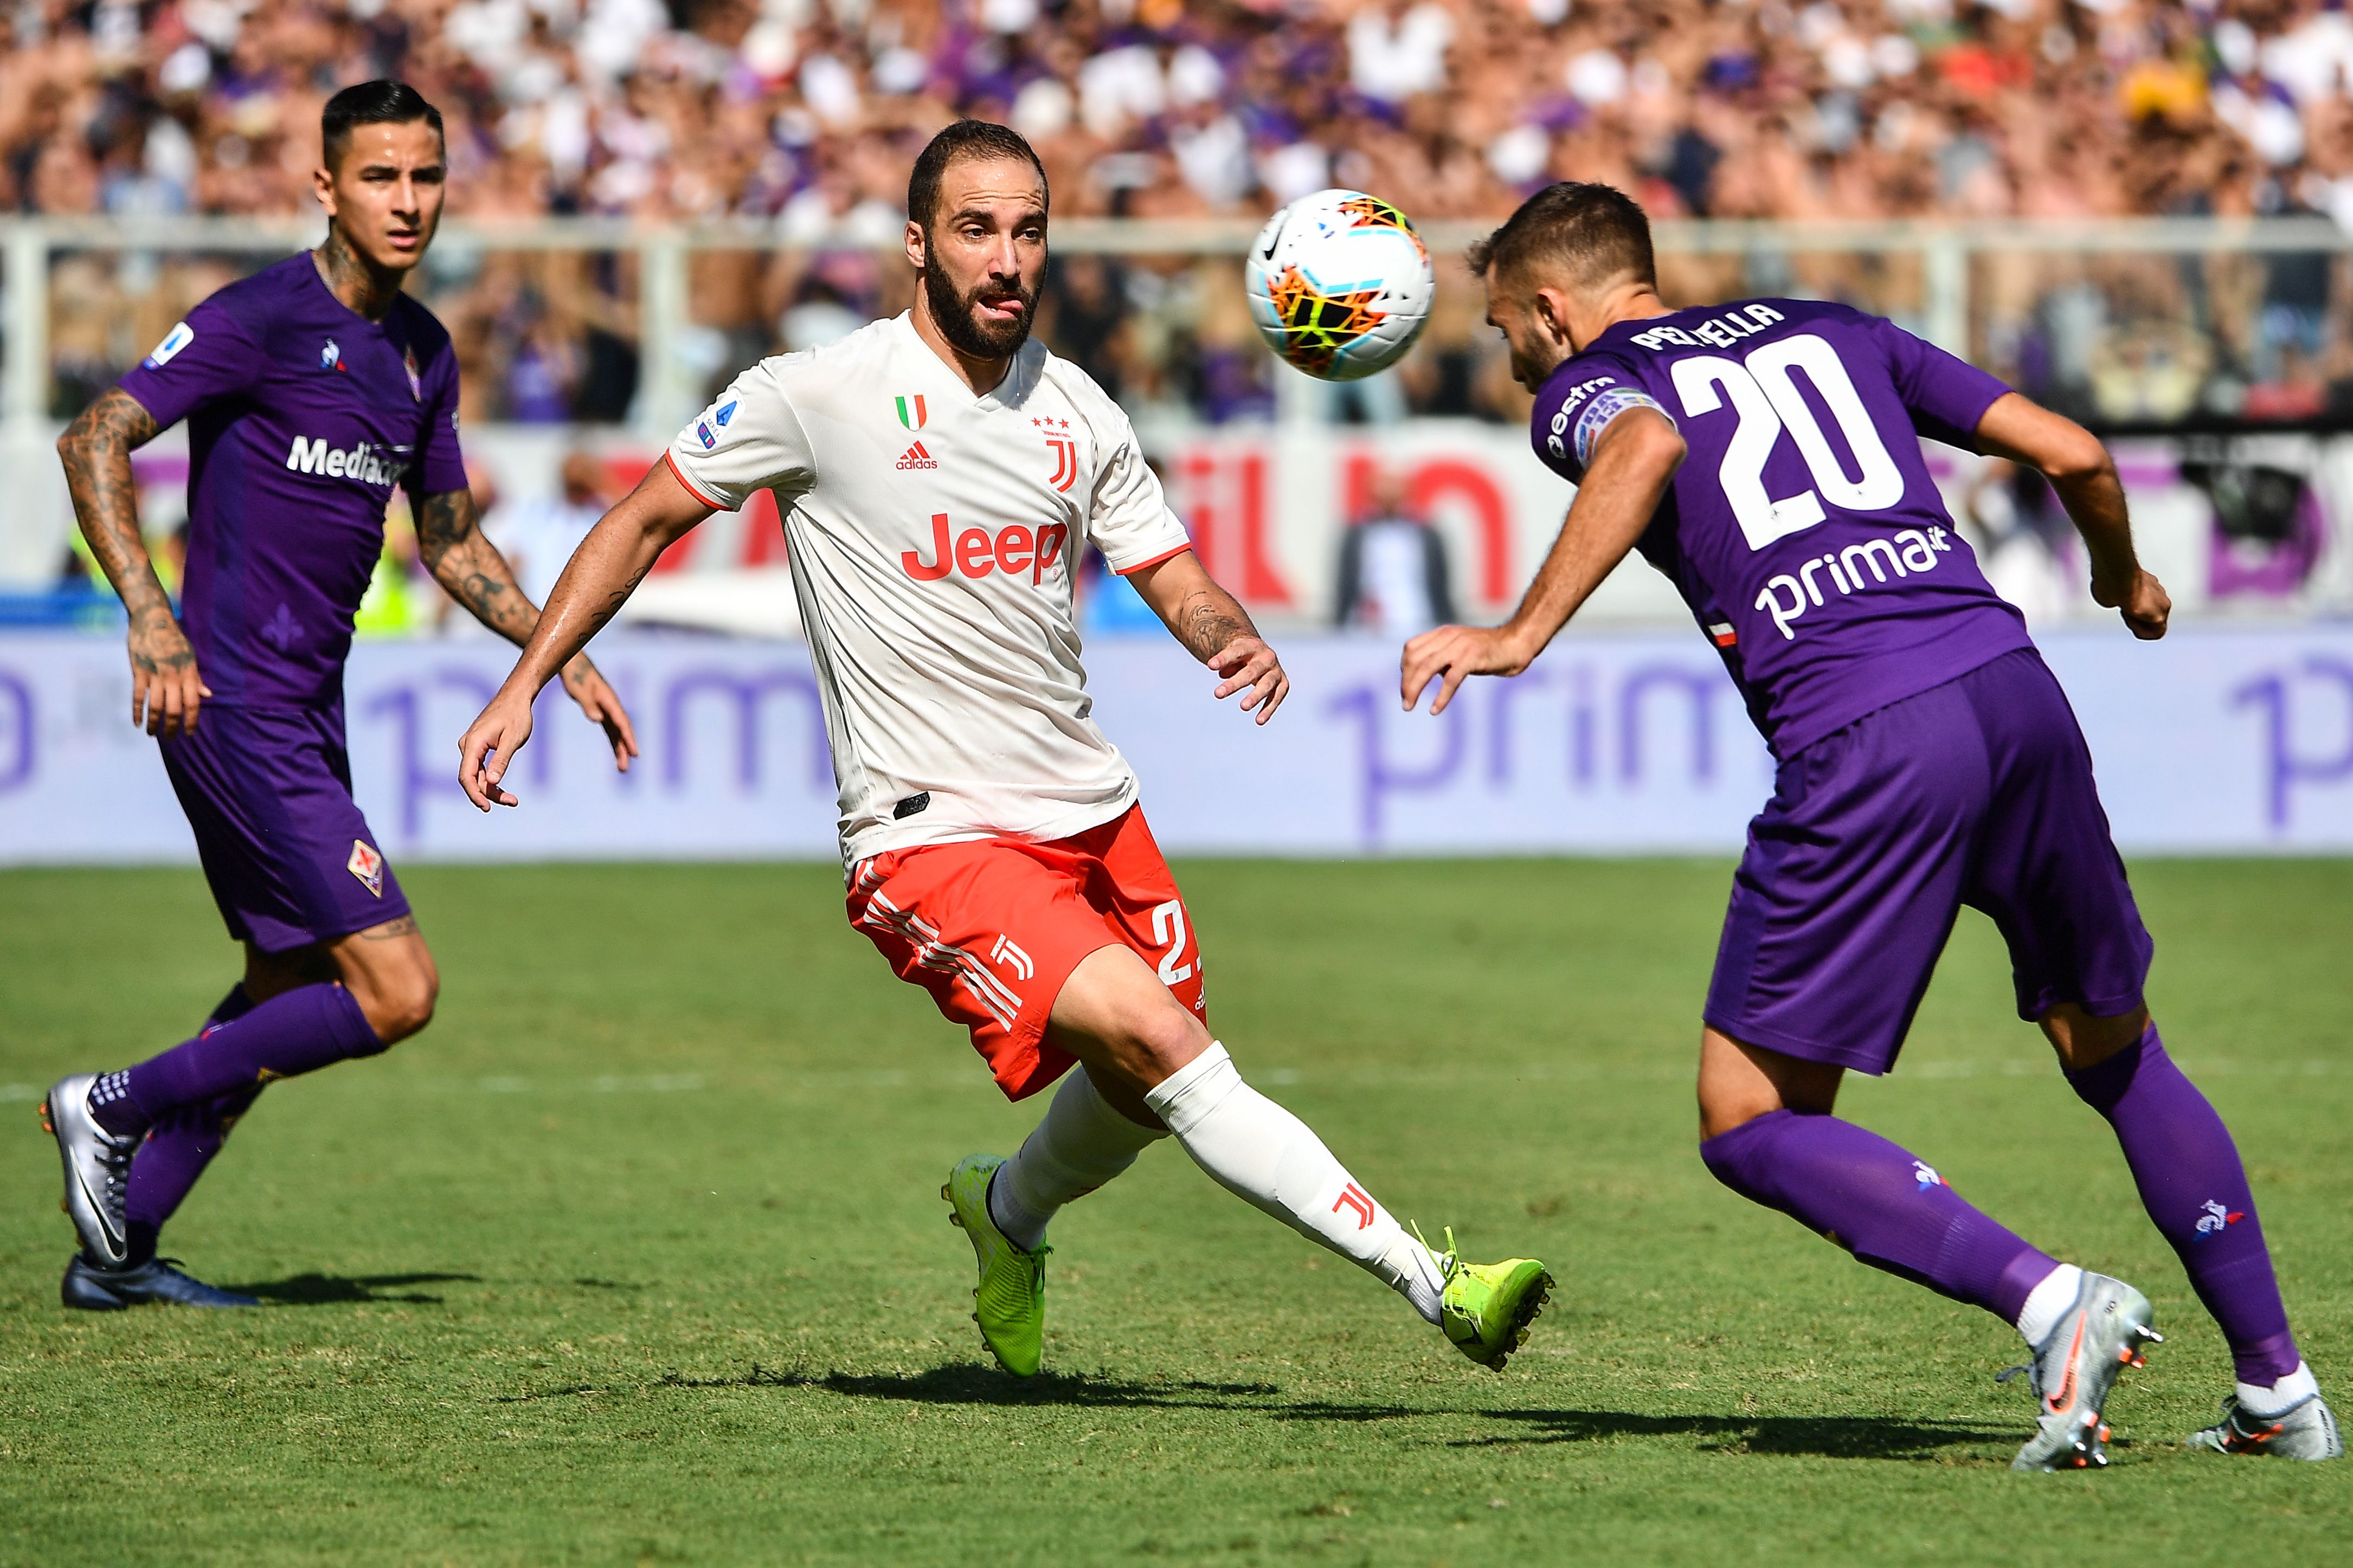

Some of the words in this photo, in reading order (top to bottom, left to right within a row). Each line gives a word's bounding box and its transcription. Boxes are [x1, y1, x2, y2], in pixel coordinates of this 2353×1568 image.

[896, 459, 938, 470] adidas
[1670, 333, 1905, 552] 20
[901, 513, 1068, 587] Jeep
[1152, 899, 1202, 986] 2
